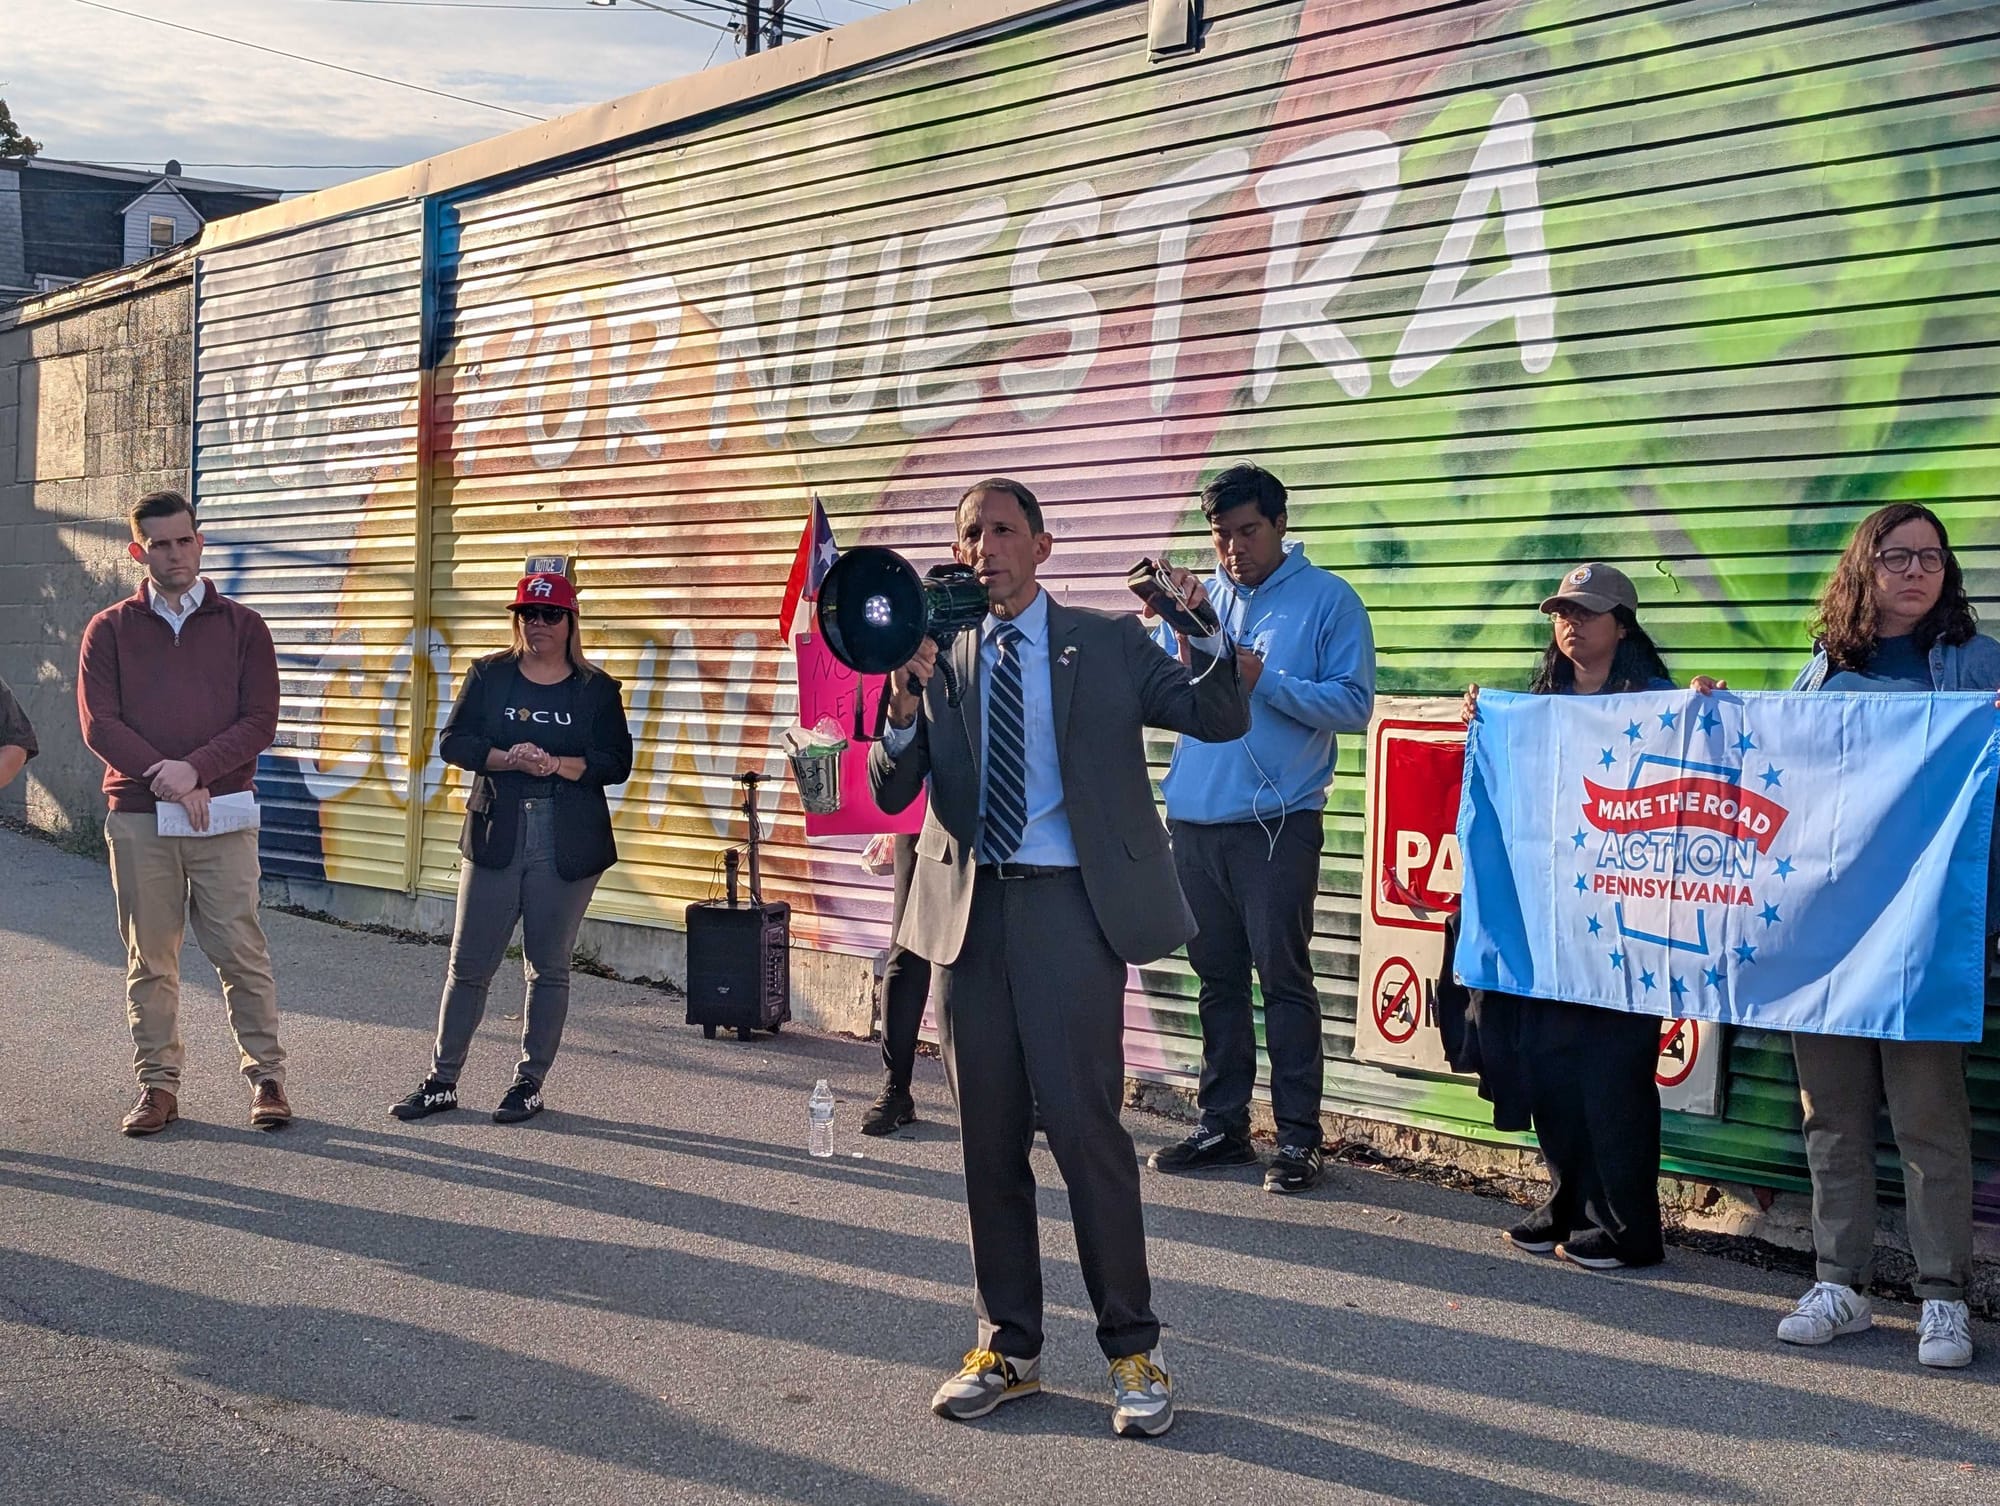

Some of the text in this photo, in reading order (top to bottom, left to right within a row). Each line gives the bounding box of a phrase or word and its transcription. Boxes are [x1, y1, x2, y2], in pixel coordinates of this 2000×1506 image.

[458, 275, 684, 474] POR
[708, 92, 1559, 450] NUESTRA
[534, 558, 556, 572] NOTICE
[1597, 791, 1771, 835] MAKE THE ROAD
[1396, 830, 1463, 894] PA
[1596, 828, 1758, 879] ACTION
[1593, 873, 1755, 907] PENNSYLVANIA
